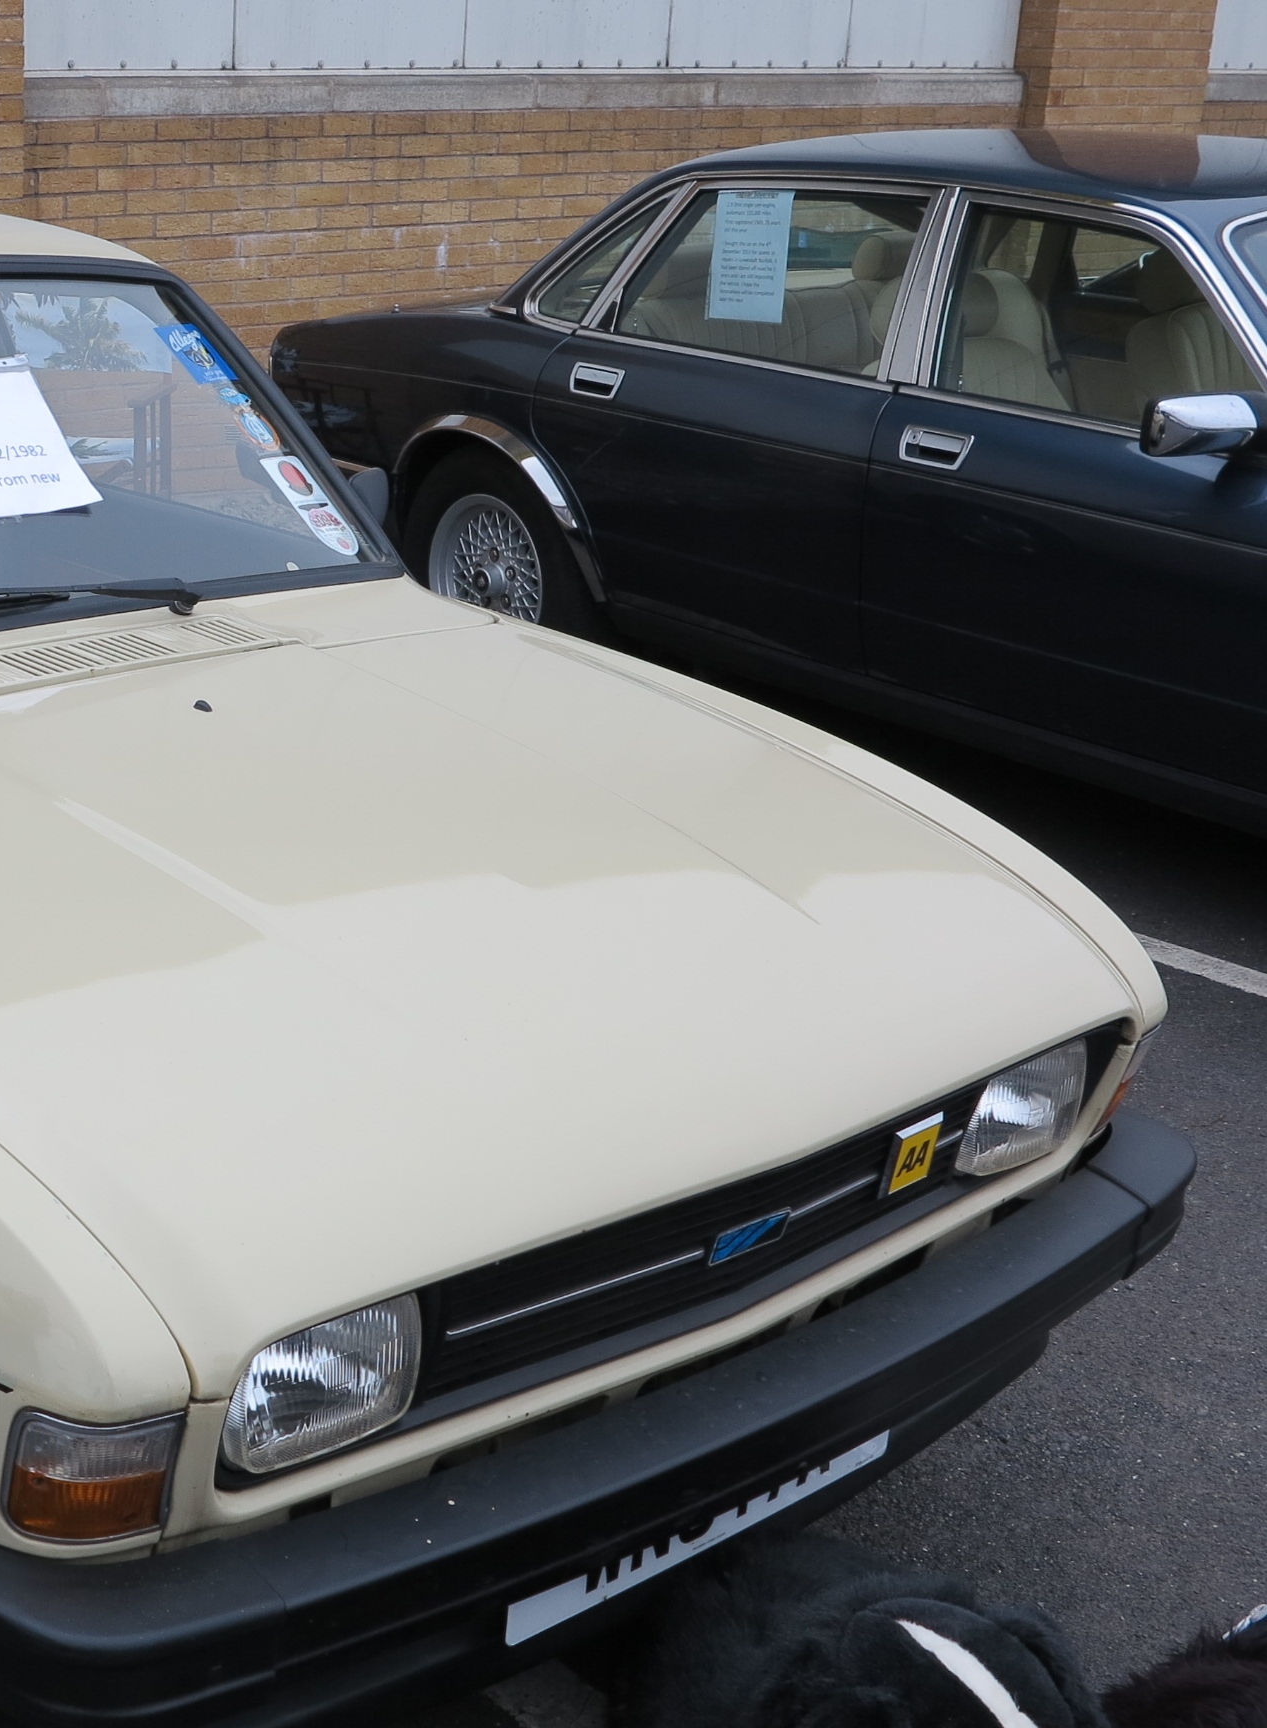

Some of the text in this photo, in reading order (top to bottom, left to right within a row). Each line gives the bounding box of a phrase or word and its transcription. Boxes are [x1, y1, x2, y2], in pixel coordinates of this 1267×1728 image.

[168, 328, 200, 352] Allegro
[31, 471, 61, 483] new
[897, 1139, 930, 1178] AA
